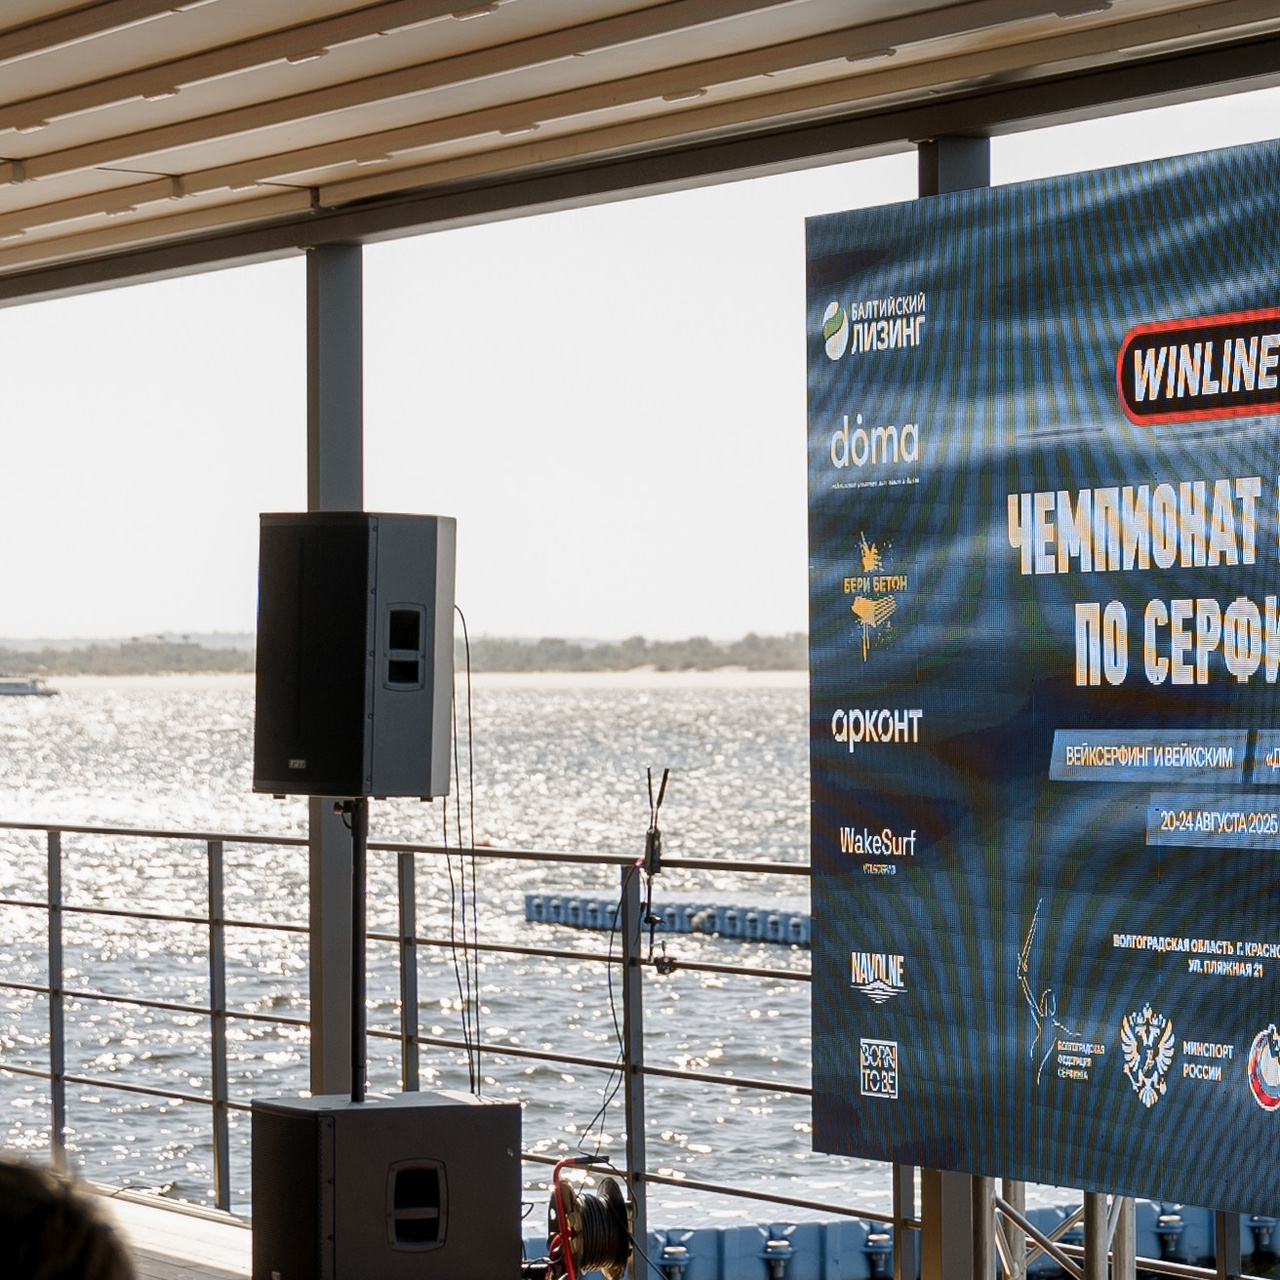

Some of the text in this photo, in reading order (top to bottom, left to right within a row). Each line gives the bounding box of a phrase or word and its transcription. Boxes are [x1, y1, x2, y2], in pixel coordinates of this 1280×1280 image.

[850, 292, 926, 321] БАЛТИЙСКИЙ
[850, 315, 926, 355] ЛИЗИНГ
[1007, 477, 1262, 576] ЧЕМПИОНАТ
[843, 575, 908, 594] БЕРИ БЕТОН
[1074, 600, 1129, 687] ПО
[1065, 742, 1233, 768] ВЕЙКСЕРФИНГ И ВЕЙКСКИМ
[1160, 811, 1278, 834] 20-24 АВГУСТА 2025
[840, 827, 916, 856] WakeSurf
[1113, 934, 1190, 952] ВОЛГОГРАДСКАЯ
[1190, 938, 1233, 956] ОБЛАСТЬ
[1236, 941, 1244, 956] Г.
[851, 952, 904, 987] NAVOLNE
[1188, 958, 1203, 973] УЛ.
[1203, 960, 1252, 977] ПЛЯЖНАЯ
[861, 1045, 896, 1068] BORN
[1183, 1041, 1234, 1060] МИНСПОРТ
[863, 1070, 896, 1093] TO BE
[1183, 1064, 1223, 1082] РОССИИ
